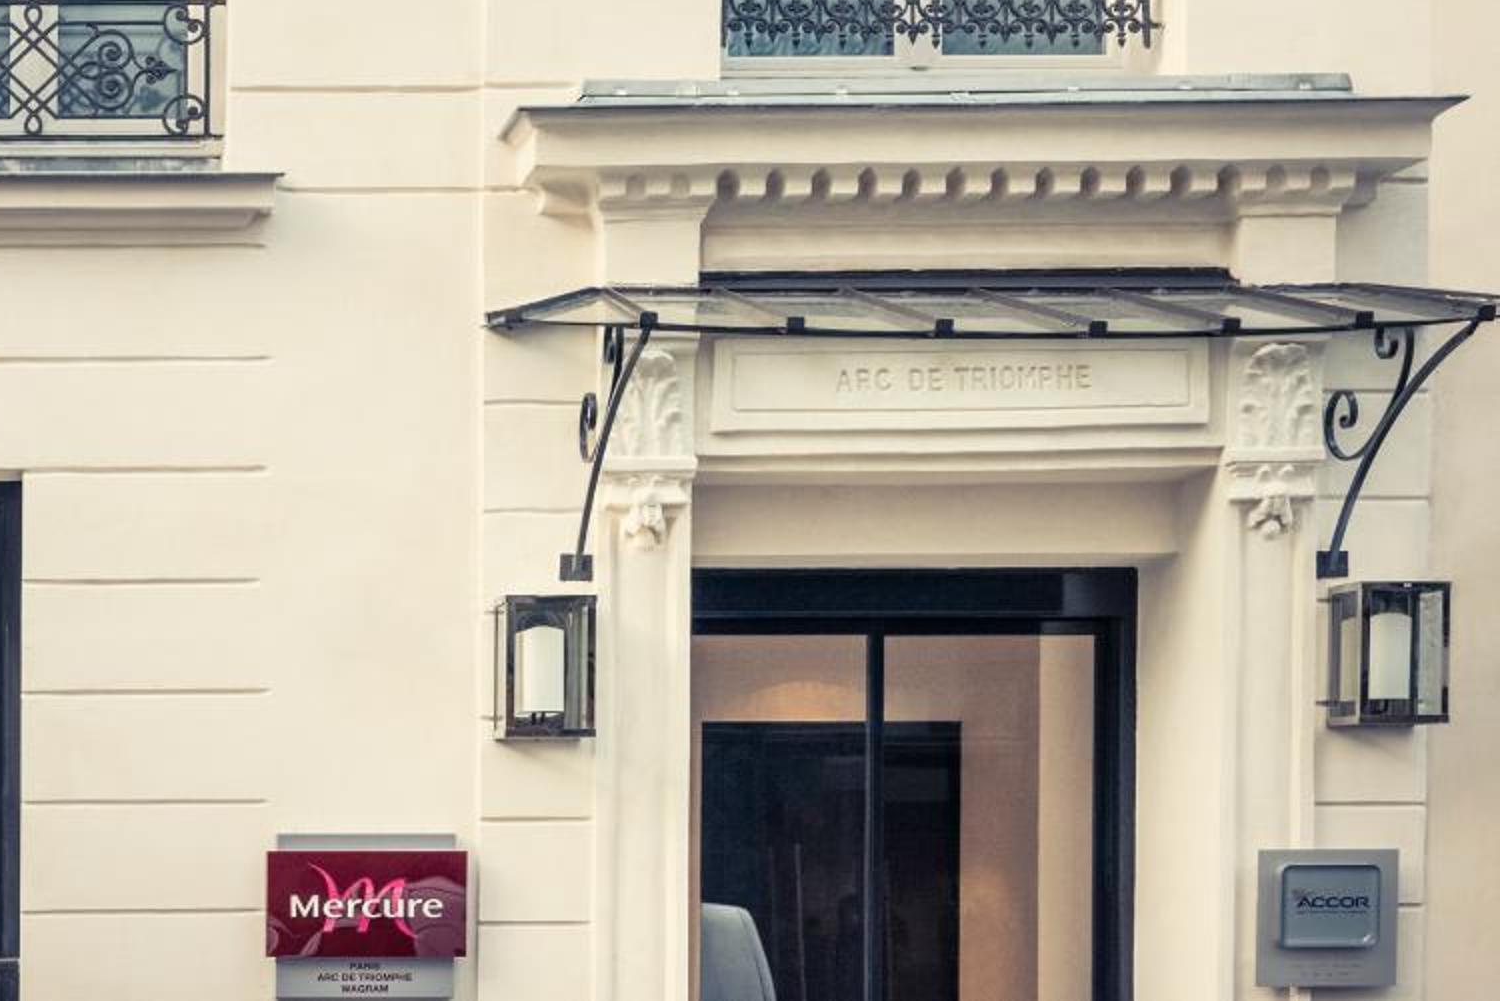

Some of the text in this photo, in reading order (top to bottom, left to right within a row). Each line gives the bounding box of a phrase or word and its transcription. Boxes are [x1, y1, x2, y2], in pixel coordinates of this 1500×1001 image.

[835, 364, 1093, 392] ARC DE TRIOMPHE
[289, 894, 444, 918] Mercure
[1296, 896, 1370, 908] ACCOR
[317, 972, 339, 982] ARC
[341, 972, 356, 982] DE
[341, 984, 389, 993] WAGRAM
